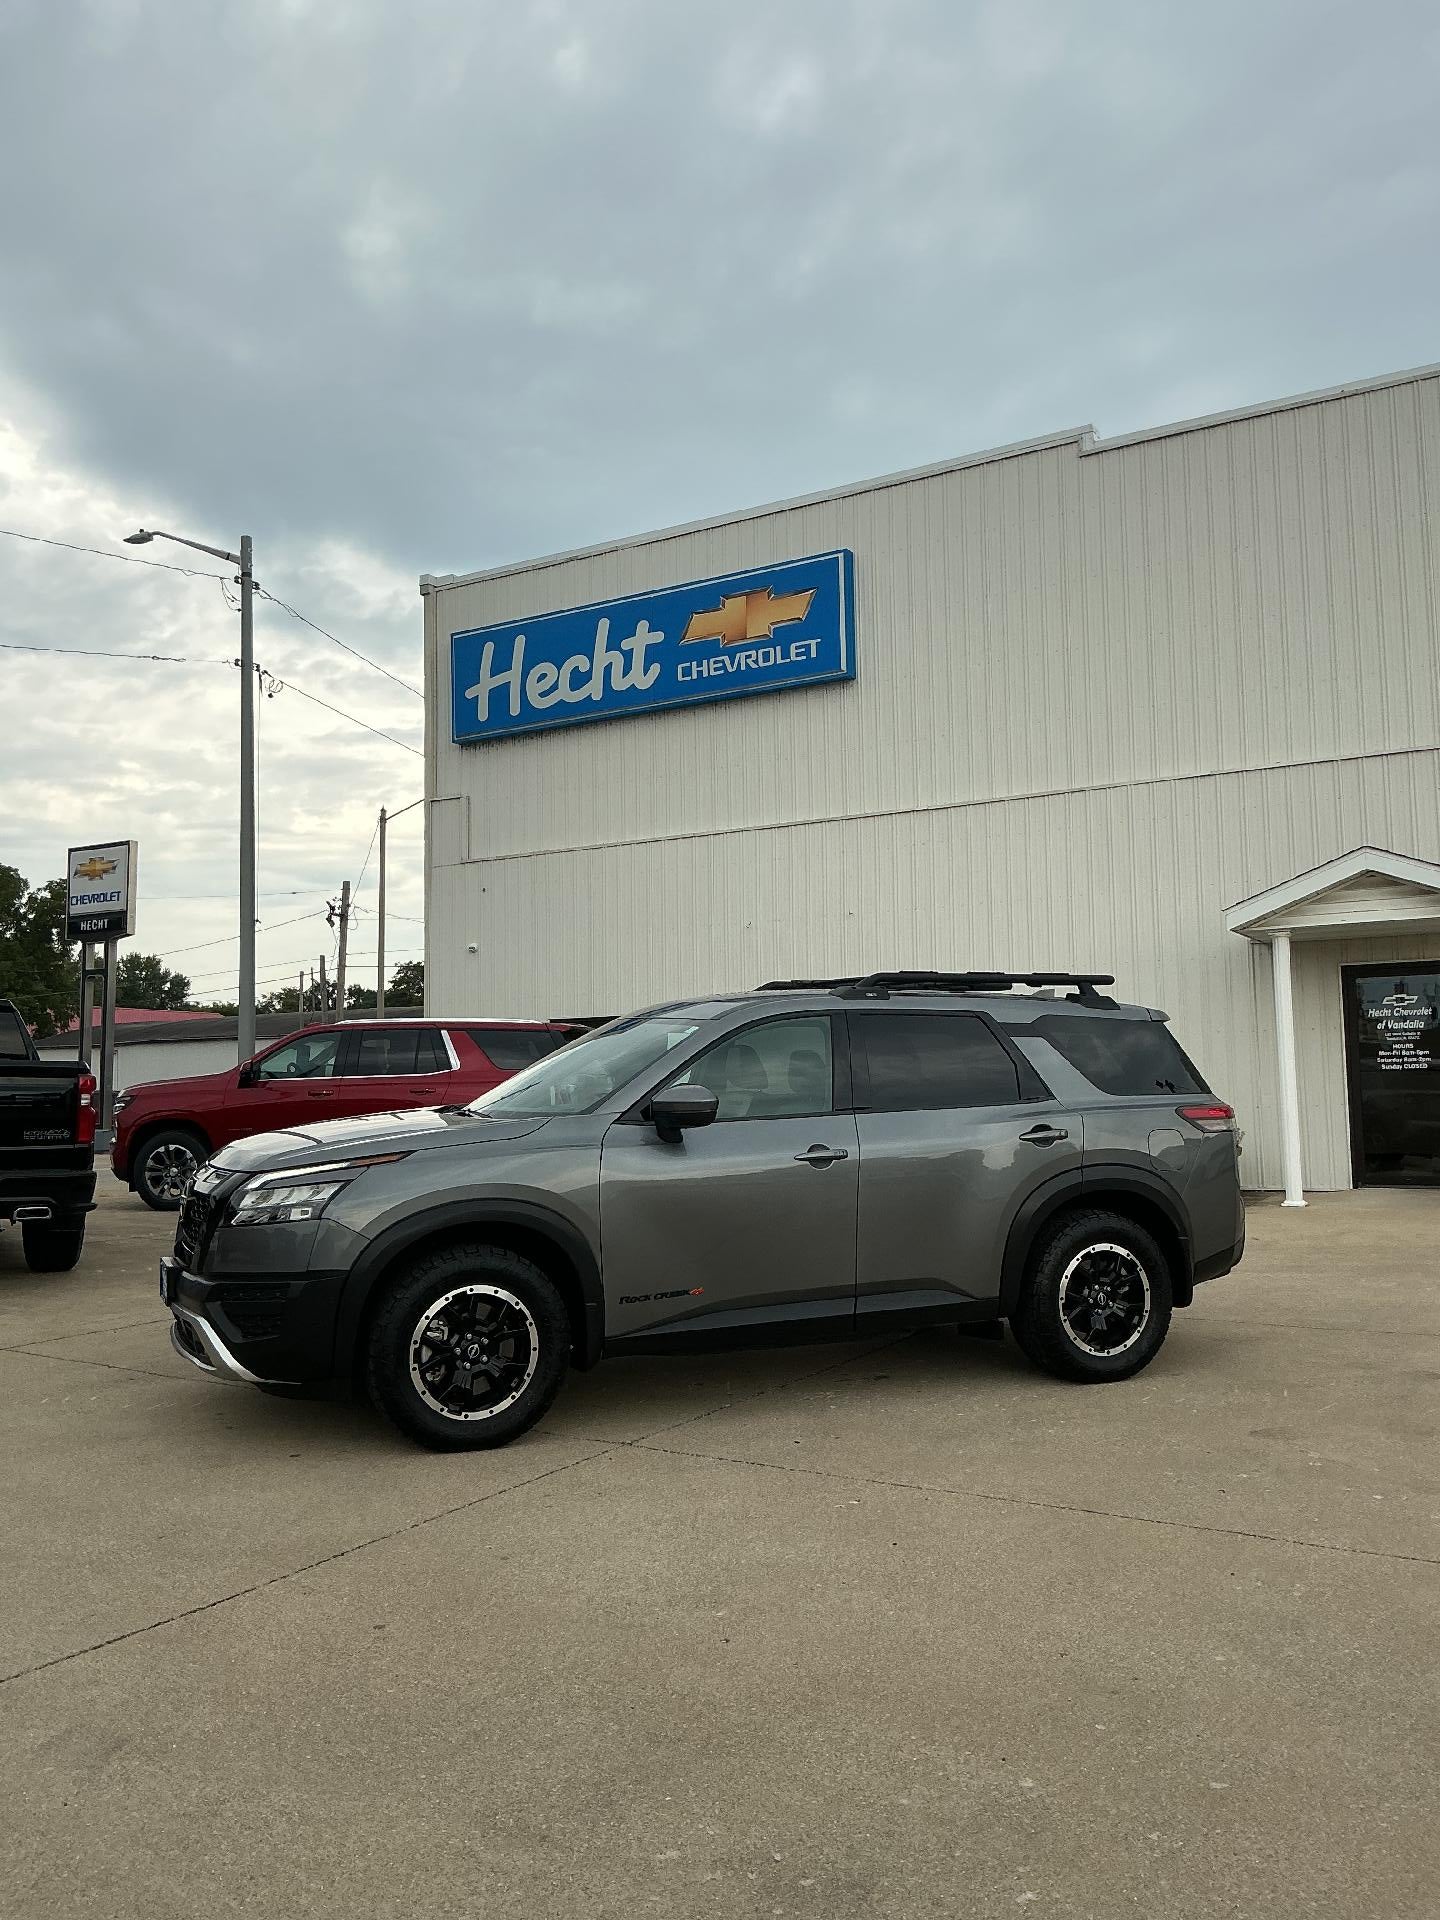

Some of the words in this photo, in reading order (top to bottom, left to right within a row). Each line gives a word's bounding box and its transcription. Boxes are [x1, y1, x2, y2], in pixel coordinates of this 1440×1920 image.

[677, 638, 821, 681] CHEVROLET
[465, 618, 664, 722] Hecht
[70, 891, 121, 906] CHEVROLET
[80, 919, 109, 931] HECHT
[1368, 1008, 1392, 1017] Hecht
[1394, 1007, 1432, 1016] Chevrolet
[1377, 1020, 1386, 1029] of
[1388, 1020, 1425, 1029] Vandalia
